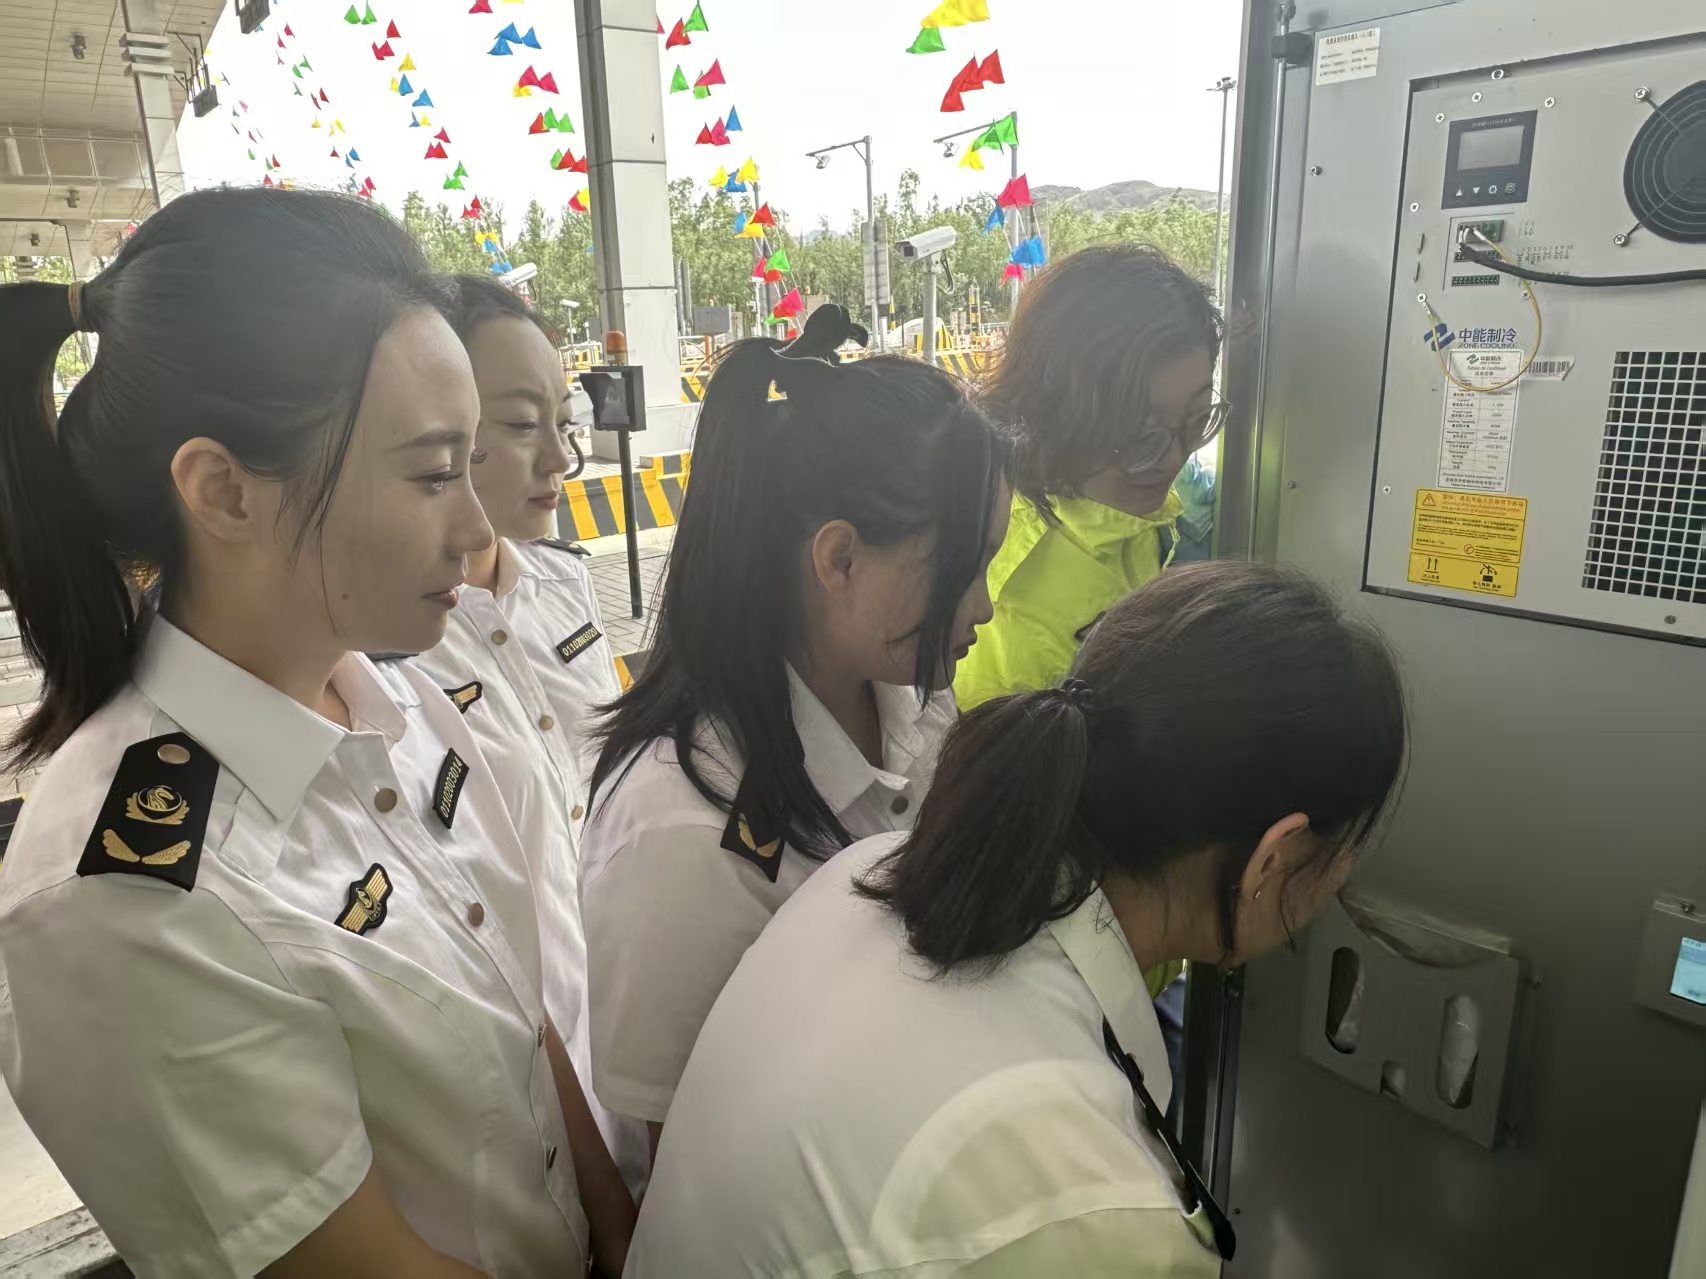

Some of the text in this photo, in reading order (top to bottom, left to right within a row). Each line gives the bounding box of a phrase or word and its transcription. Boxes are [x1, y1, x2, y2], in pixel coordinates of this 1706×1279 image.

[1459, 327, 1517, 342] 中能制冷
[440, 756, 463, 818] 01102003014
